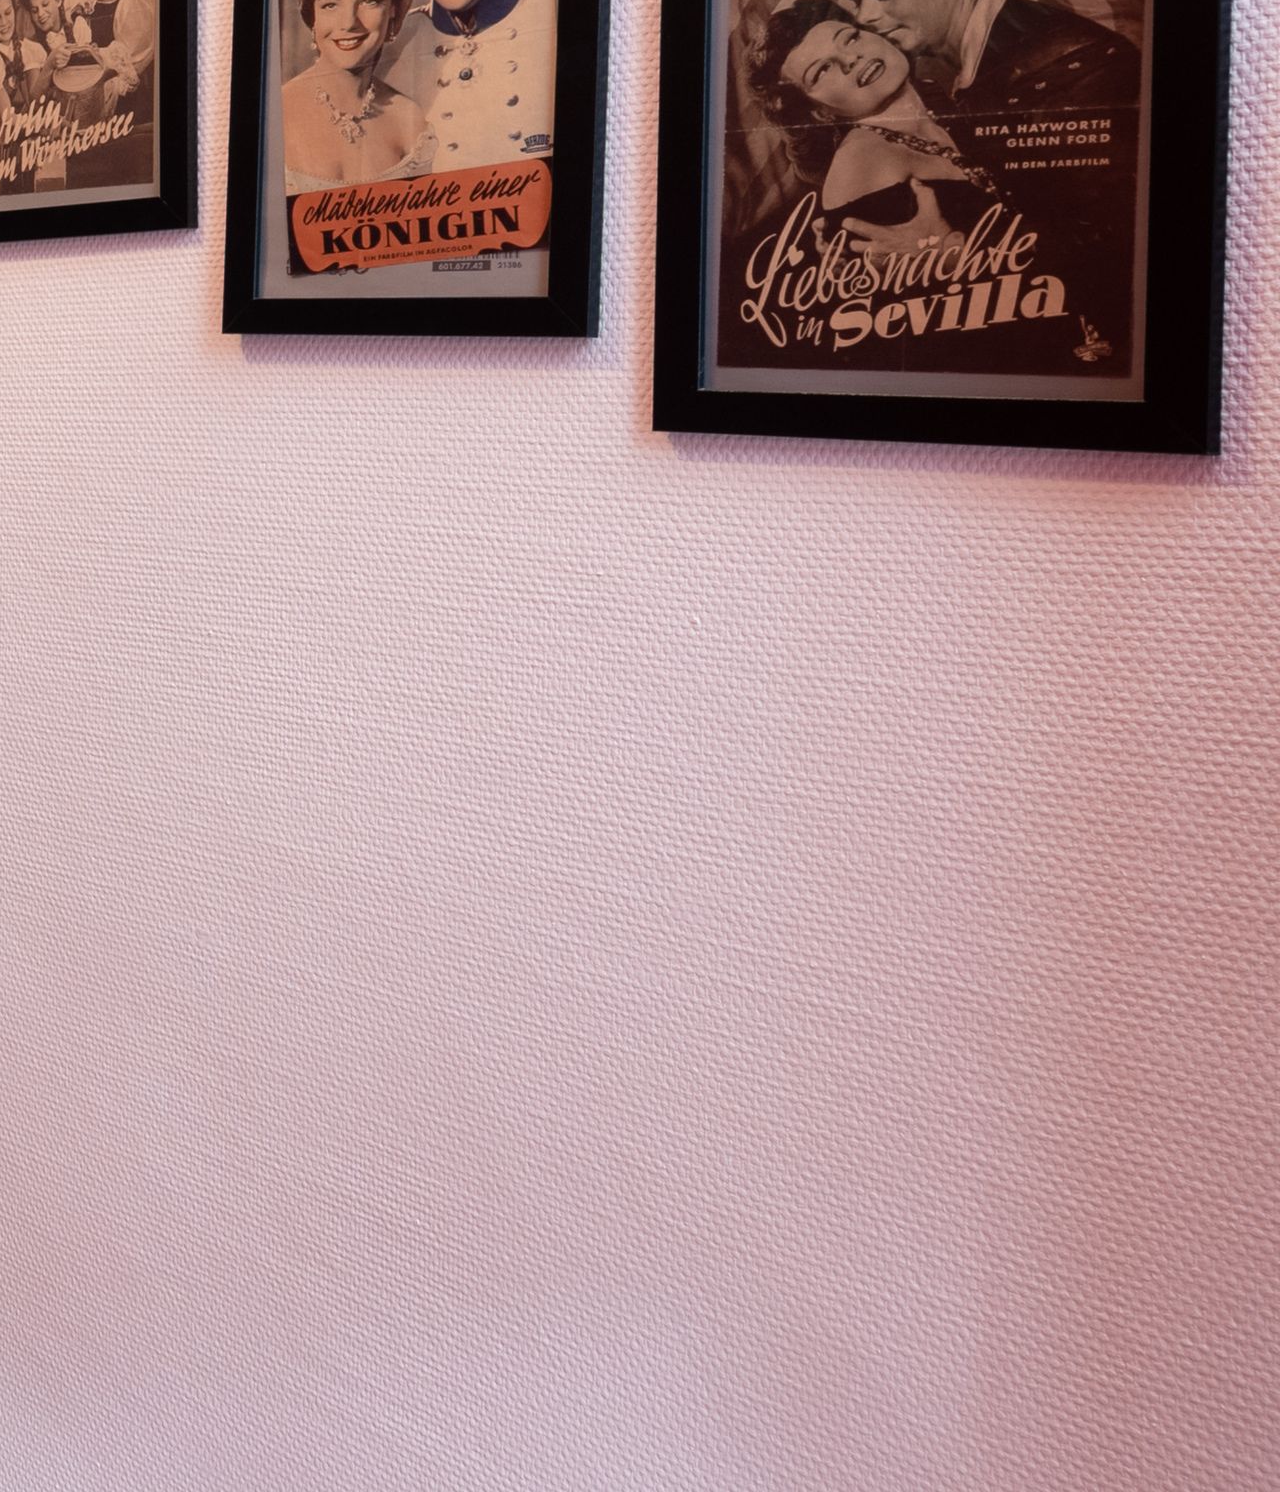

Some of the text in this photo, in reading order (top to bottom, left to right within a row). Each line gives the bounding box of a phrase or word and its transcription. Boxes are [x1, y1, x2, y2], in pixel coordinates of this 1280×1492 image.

[20, 110, 135, 173] Wörthersee
[975, 119, 1112, 136] RITA HAYWORTH
[1006, 133, 1111, 148] GLENN FORD
[1005, 158, 1111, 170] IN DEM FARBFILM
[303, 168, 543, 226] Mädchenjahre einer
[321, 205, 521, 255] KÖNIGIN
[741, 191, 1039, 348] Liebesnächte
[796, 273, 1070, 353] in Sevilla
